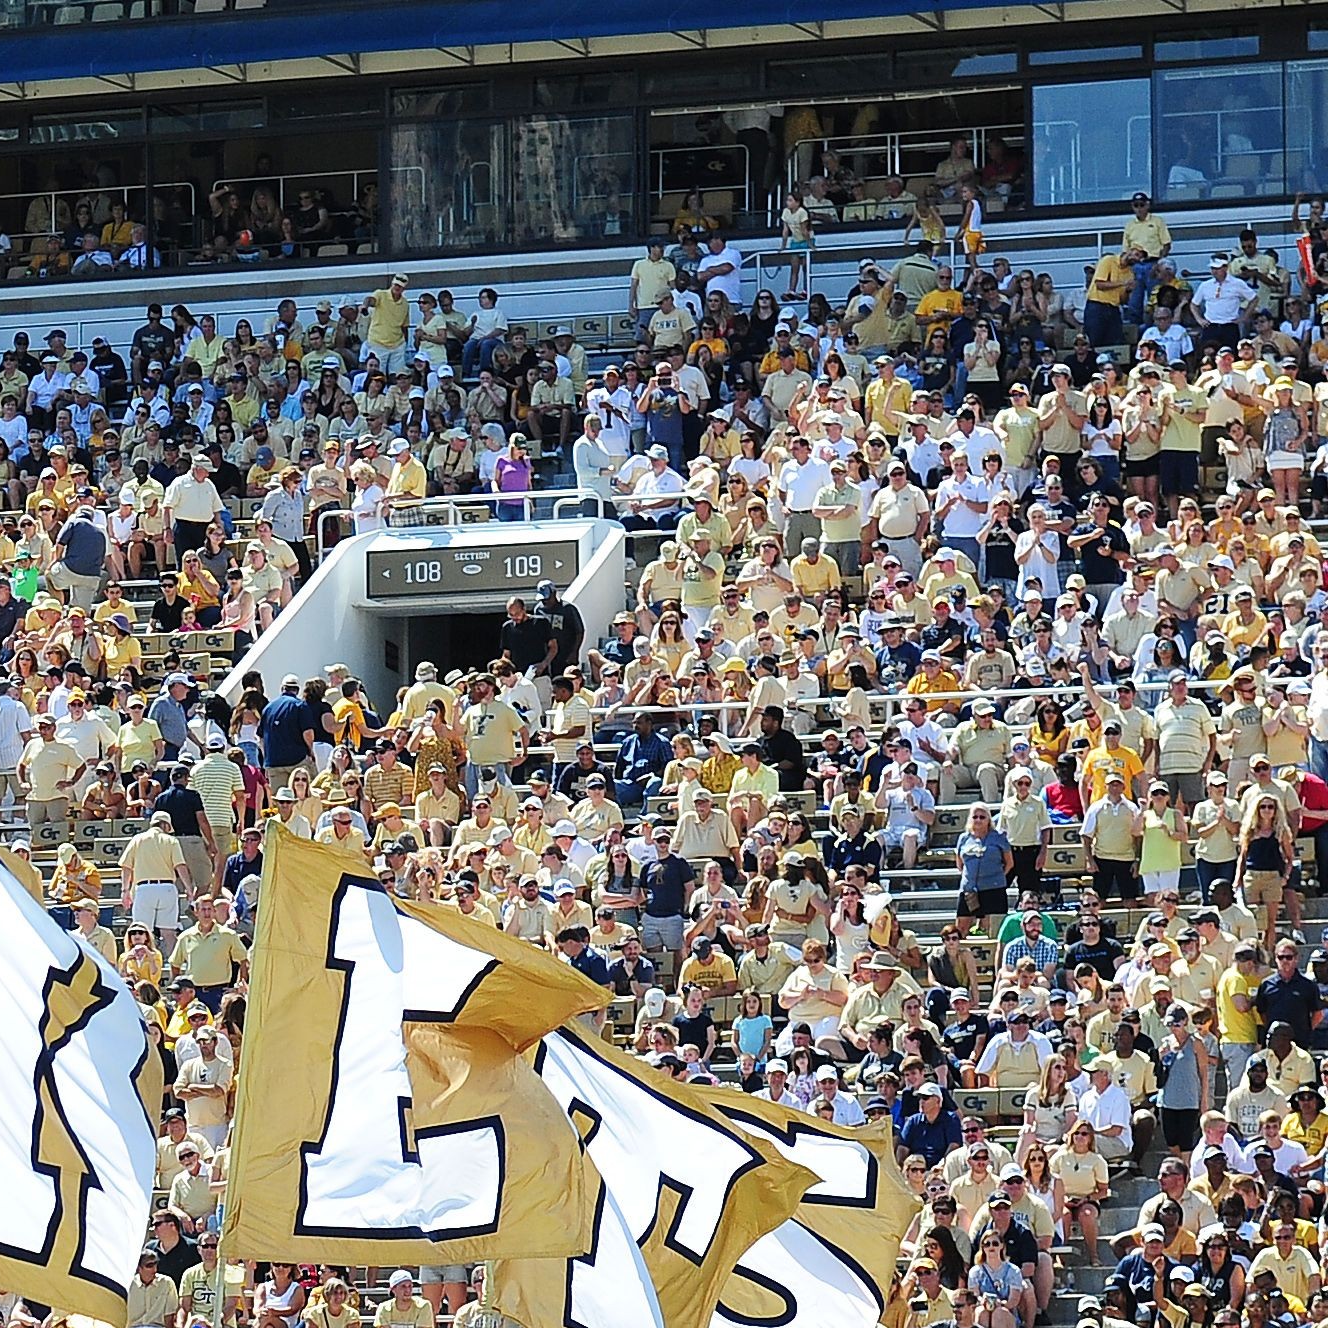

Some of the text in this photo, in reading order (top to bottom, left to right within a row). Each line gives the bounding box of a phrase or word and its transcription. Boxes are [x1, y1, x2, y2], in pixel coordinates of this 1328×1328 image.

[454, 551, 490, 561] SECTION
[404, 555, 542, 584] 108 109
